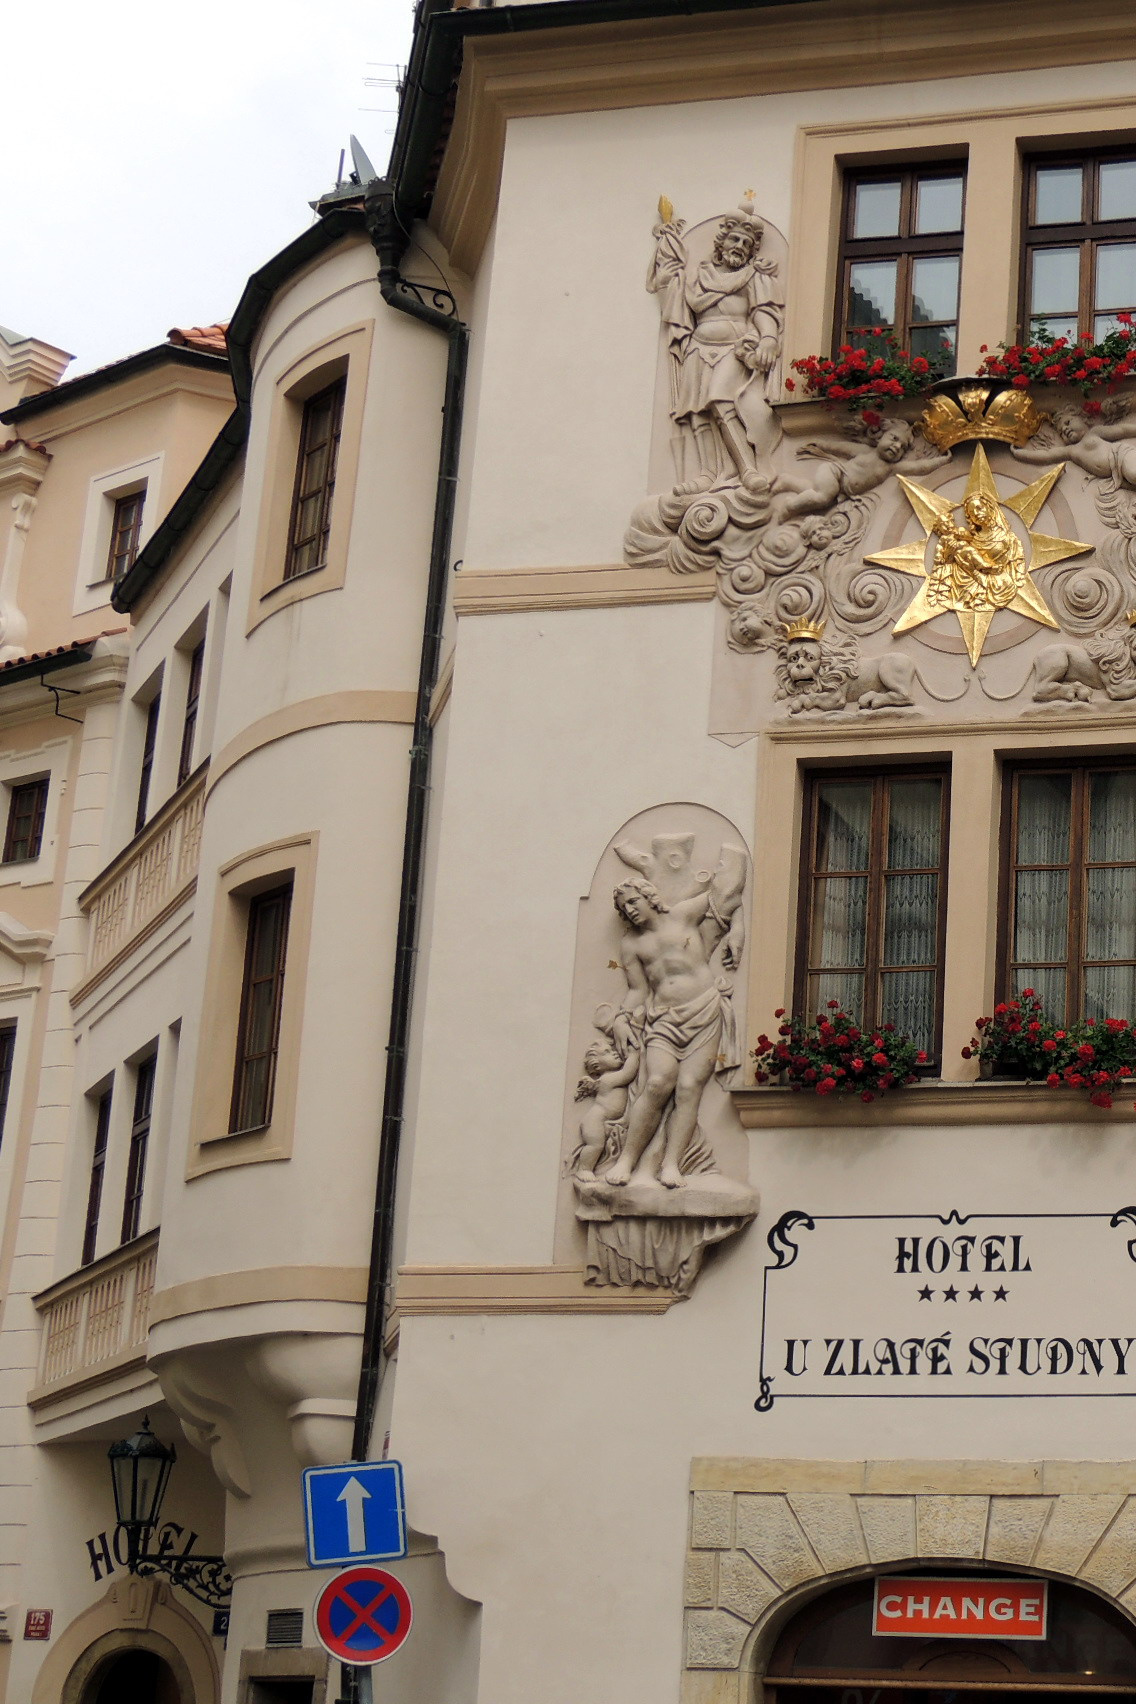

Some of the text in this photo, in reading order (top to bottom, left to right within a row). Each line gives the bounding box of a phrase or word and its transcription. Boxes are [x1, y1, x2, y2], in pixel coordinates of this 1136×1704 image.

[893, 1234, 1033, 1274] HOTEL
[783, 1338, 812, 1377] U
[822, 1331, 953, 1377] ZLATÉ
[30, 1611, 46, 1625] 175
[878, 1594, 1042, 1623] CHANGE
